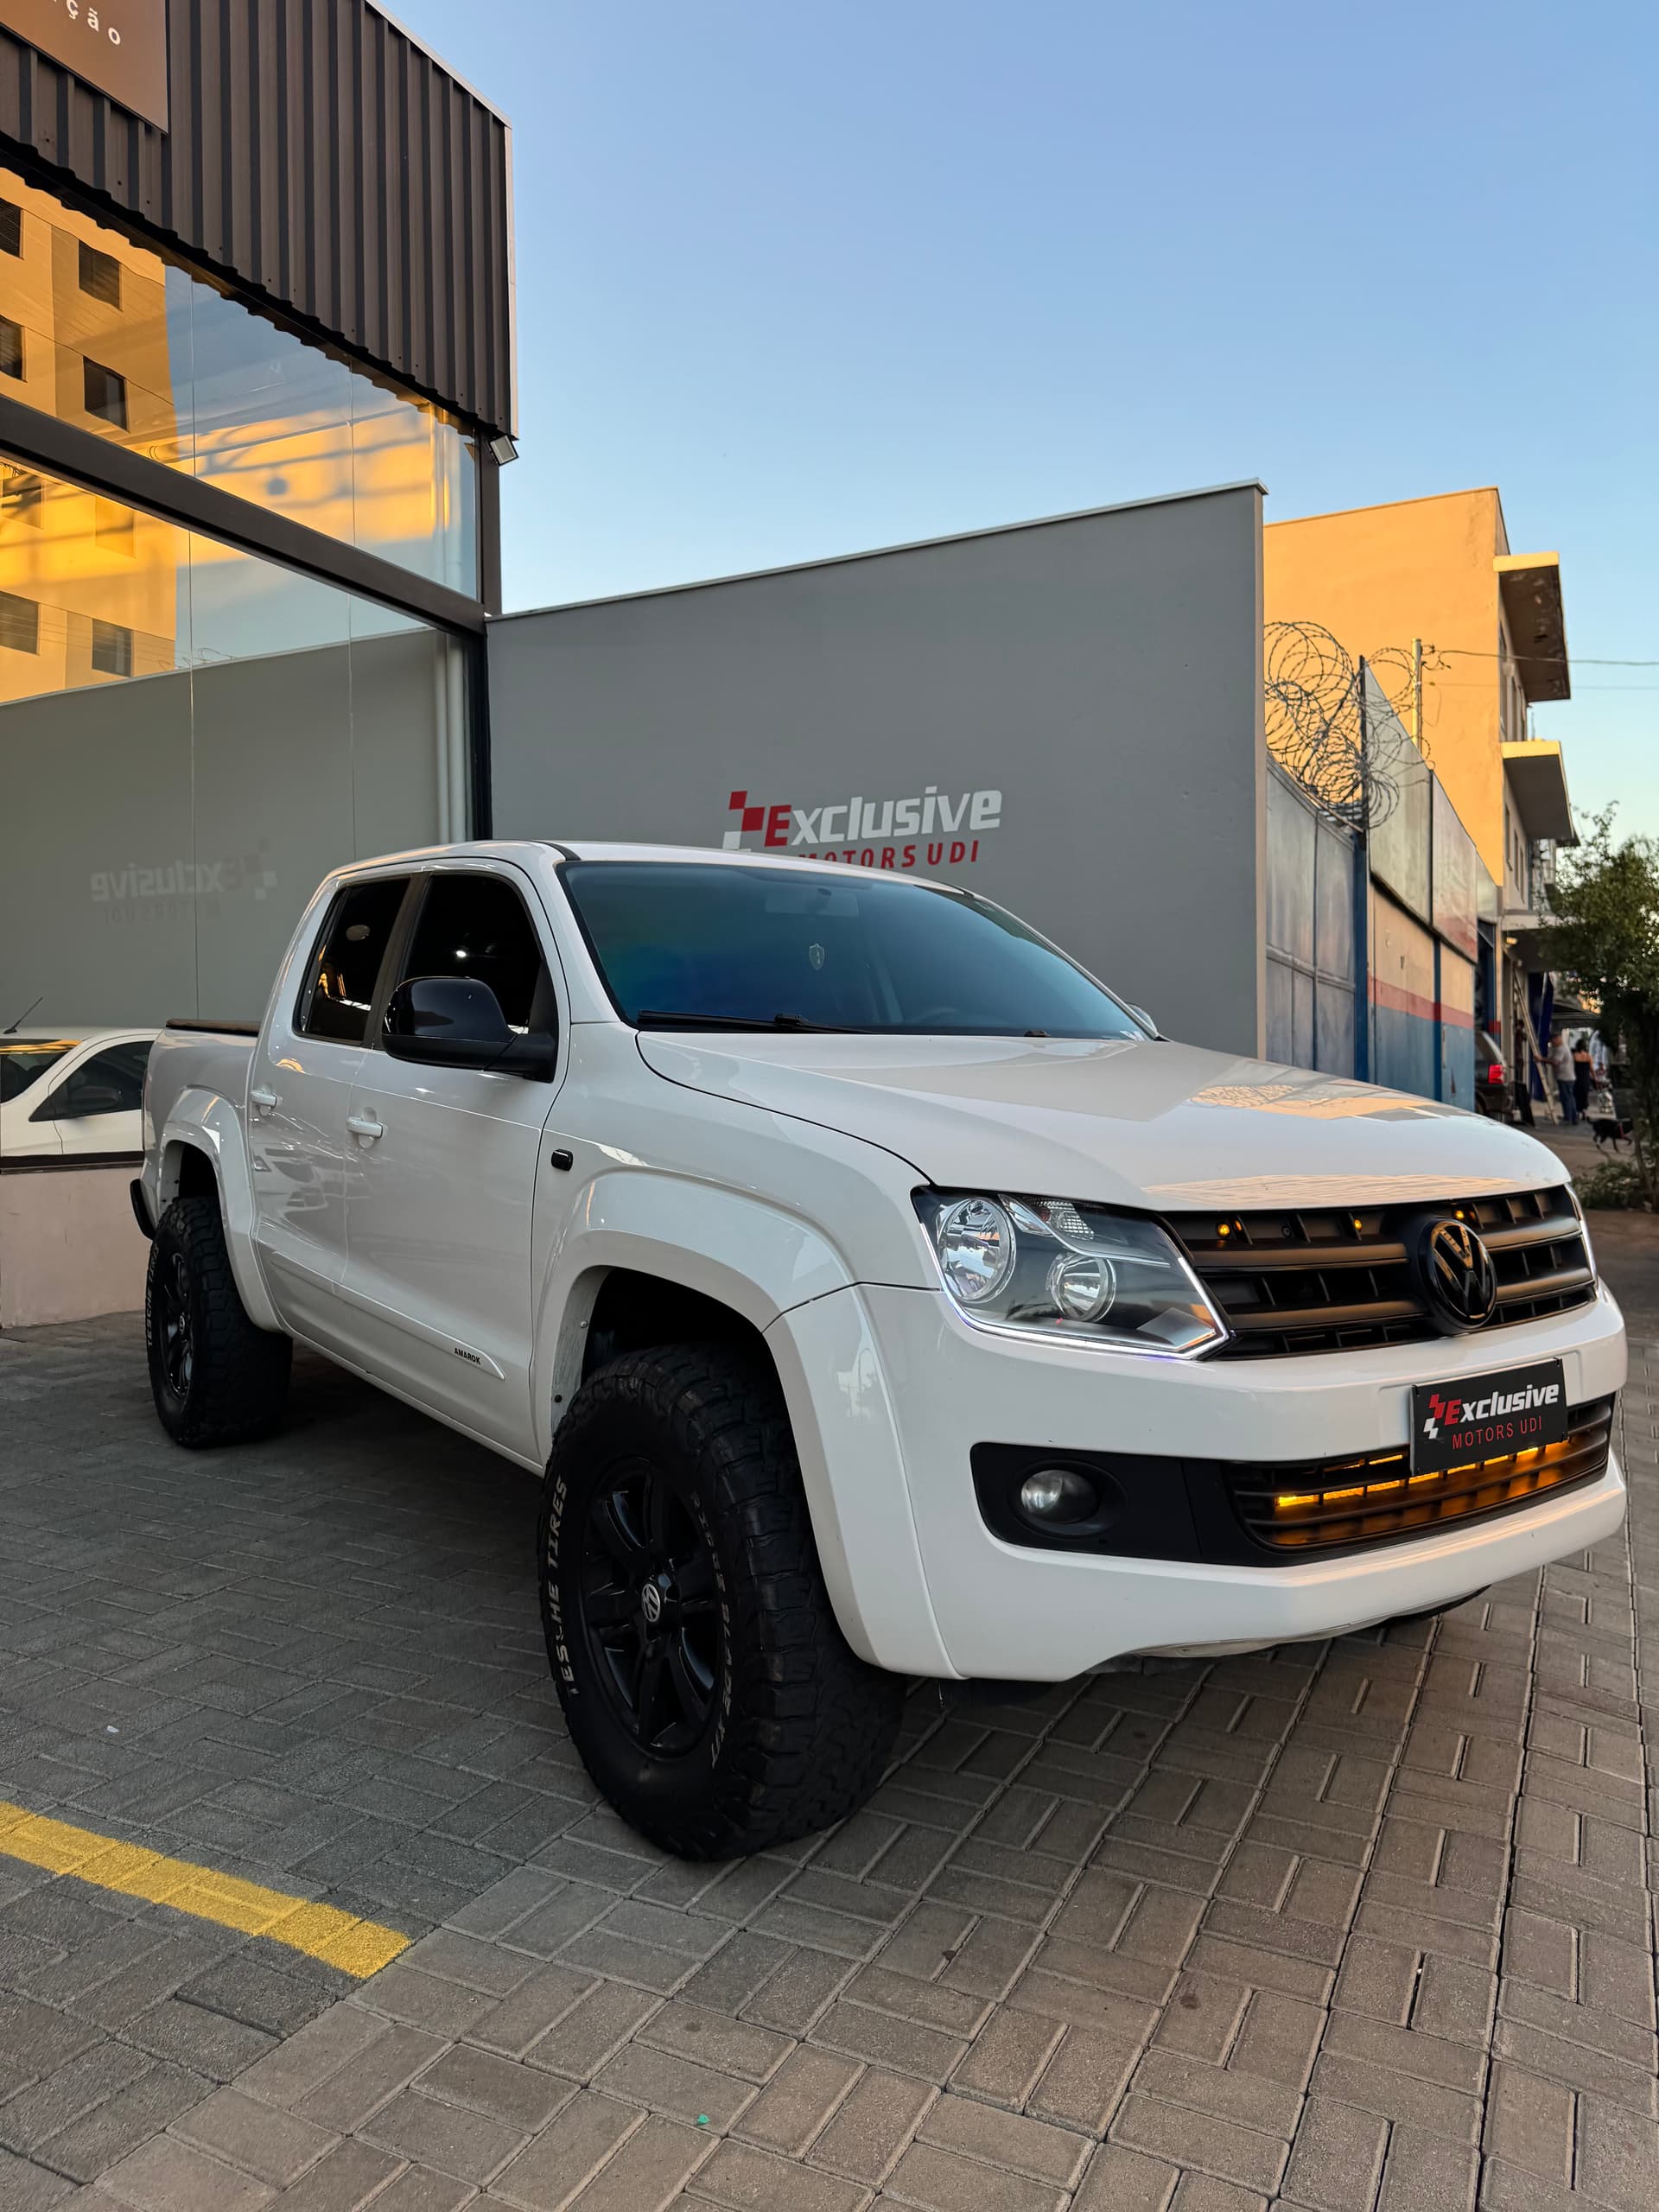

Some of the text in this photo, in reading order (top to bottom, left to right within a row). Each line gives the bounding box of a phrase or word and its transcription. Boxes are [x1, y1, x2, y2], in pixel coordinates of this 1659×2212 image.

[54, 0, 121, 45] ção
[765, 785, 1002, 848] Exclusive
[927, 840, 979, 866] UDI
[454, 1347, 481, 1365] AMAROK
[1444, 1384, 1560, 1426] Exclusive
[1452, 1415, 1542, 1450] MOTORS UDI
[547, 1474, 568, 1568] TIRES
